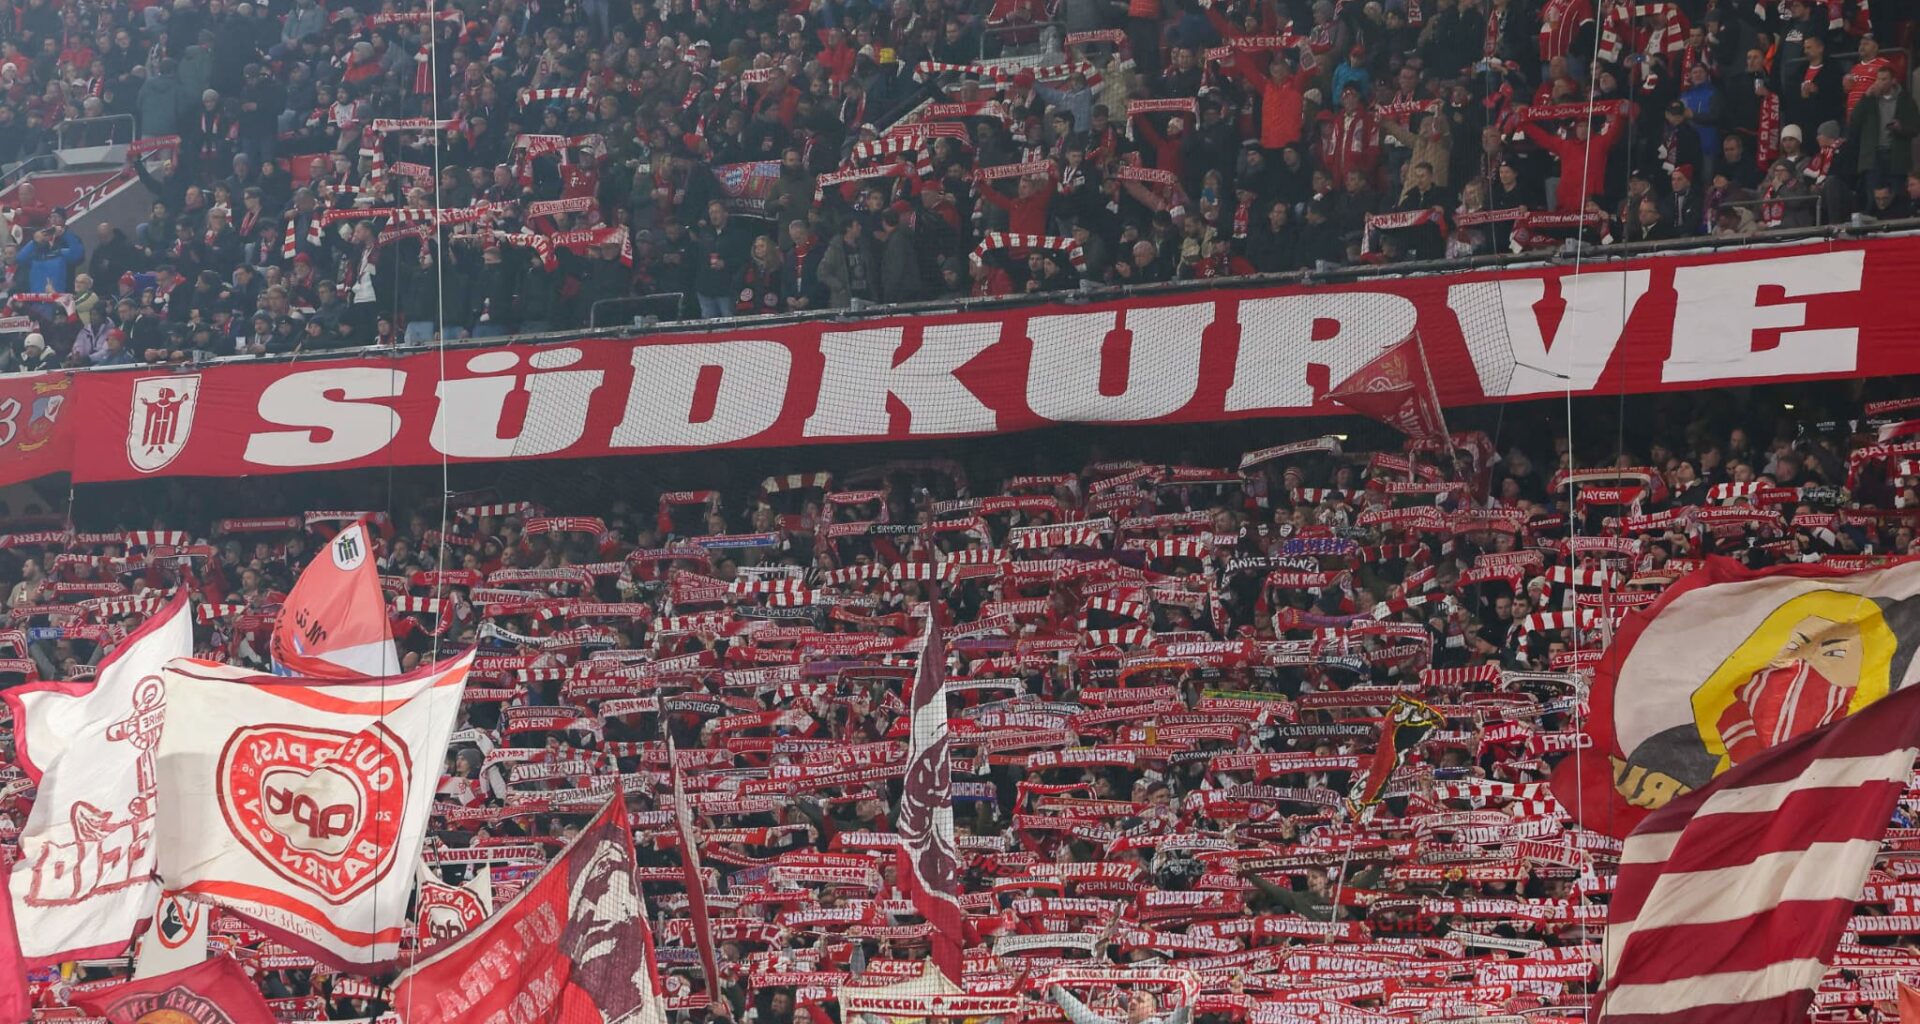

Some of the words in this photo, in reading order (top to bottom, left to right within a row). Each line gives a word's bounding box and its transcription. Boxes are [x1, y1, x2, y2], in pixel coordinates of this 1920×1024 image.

[243, 252, 1864, 467] SÜDKURVE
[1056, 561, 1106, 578] AYERN
[1268, 557, 1314, 571] FRANZ
[1273, 573, 1299, 585] SAN
[1302, 573, 1327, 584] MIA
[857, 637, 895, 652] BAYERN
[1166, 643, 1244, 657] SÜDKURVE
[482, 657, 526, 671] BAYERN
[1566, 652, 1603, 663] BAYERN
[723, 668, 766, 685] SÜDK
[664, 699, 721, 714] WEINSTEIGER
[1215, 699, 1253, 709] BAYERN
[723, 716, 762, 729] BAYERN
[1291, 726, 1326, 738] BAYERN
[1483, 726, 1508, 741] SAN
[487, 751, 505, 762] SAN
[1028, 755, 1057, 769] FÜR
[1061, 750, 1136, 765] MÜNCHEN
[815, 771, 859, 787] BAYERN
[1075, 805, 1105, 817] SAN
[1107, 803, 1135, 816] MIA
[1501, 826, 1515, 837] 72
[1516, 818, 1560, 837] URVE
[1028, 861, 1098, 878] SÜDKURVE
[1101, 861, 1133, 878] 1972
[1892, 860, 1920, 876] SÜ
[886, 901, 908, 911] MIA
[1263, 920, 1351, 937] SÜDKURVE
[1847, 914, 1920, 933] SÜDKURV
